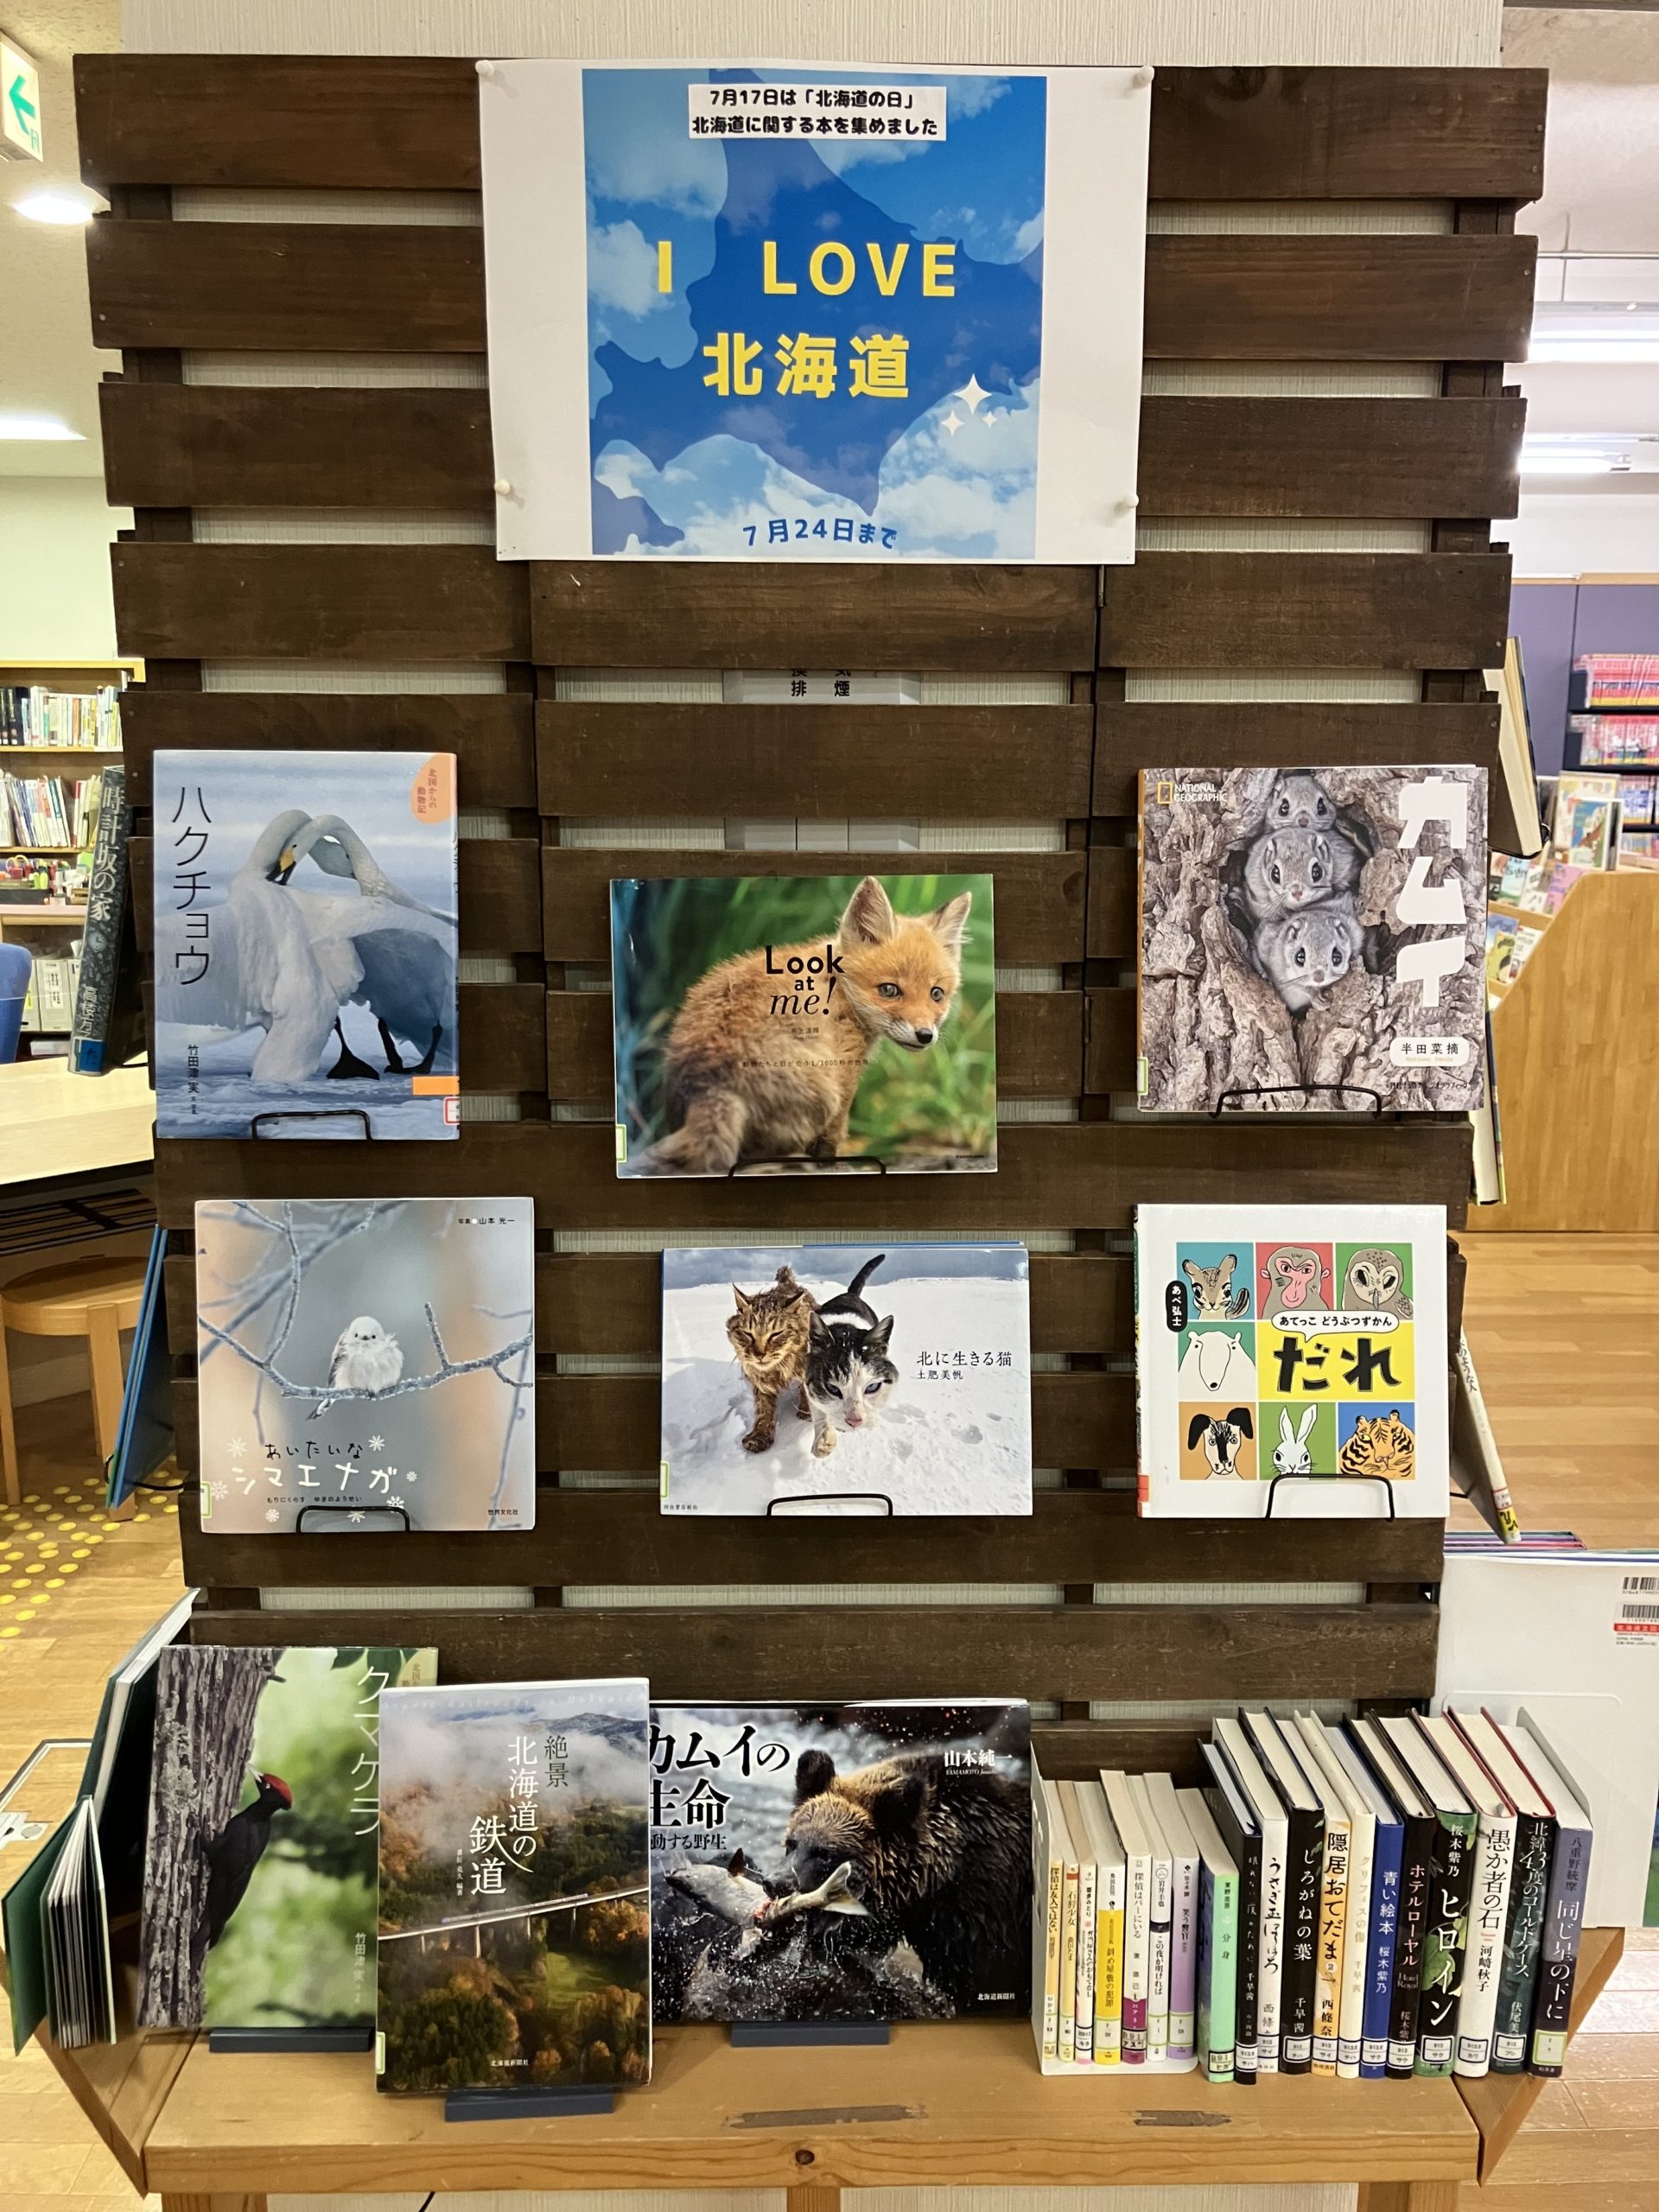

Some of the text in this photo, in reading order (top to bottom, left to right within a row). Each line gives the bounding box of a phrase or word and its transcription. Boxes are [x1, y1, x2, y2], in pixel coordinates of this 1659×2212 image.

[709, 88, 914, 110] 7月17日は「北海道の日」
[692, 115, 938, 136] 北海道に関する本を集めました
[658, 241, 956, 297] I LOVE
[702, 332, 910, 398] 北海道
[743, 518, 897, 550] 7月24日まで
[1173, 792, 1227, 803] GEOGRAPHIC
[1174, 784, 1217, 793] NATIONAL
[90, 786, 125, 922] 時計坂の家
[172, 786, 213, 986] ハクチョウ
[1395, 776, 1468, 1007] カムイ
[766, 944, 844, 975] Look
[794, 976, 814, 991] at
[770, 976, 836, 1015] me!
[1402, 1042, 1459, 1054] 半田菜摘
[1172, 1286, 1182, 1327] あべ弘士
[1279, 1315, 1392, 1327] あてっこ どうぶつずかん
[916, 1351, 1012, 1367] 北に生きる猫
[917, 1370, 963, 1380] 土肥美帆
[1274, 1337, 1402, 1392] だれ
[264, 1441, 363, 1459] あいたいな
[232, 1462, 397, 1494] シマエナガ
[544, 1735, 569, 1789] 絶景
[650, 1726, 791, 1777] カムイの
[944, 1749, 1013, 1767] 山本純一
[507, 1735, 538, 1857] 北海道の
[650, 1778, 730, 1829] 生命
[469, 1815, 527, 1896] 鉄道
[1447, 1824, 1465, 1877] 桜木紫乃
[1048, 1867, 1059, 1933] 探偵は友人ではない
[1322, 1833, 1349, 1960] 隠居おてだま
[1378, 1871, 1398, 1936] 青い絵本
[1478, 1829, 1510, 1929] 愚か者の石
[1294, 1849, 1314, 1961] しろがねの葉
[1402, 1865, 1425, 1966] ホテルローヤル
[1154, 1936, 1164, 1995] この夜が明ければ
[1222, 1933, 1231, 1960] 分身
[1430, 1889, 1460, 2025] ヒロイン
[1547, 1900, 1580, 2019] 同じ星の下に
[1508, 2001, 1522, 2036] 伏尾美
